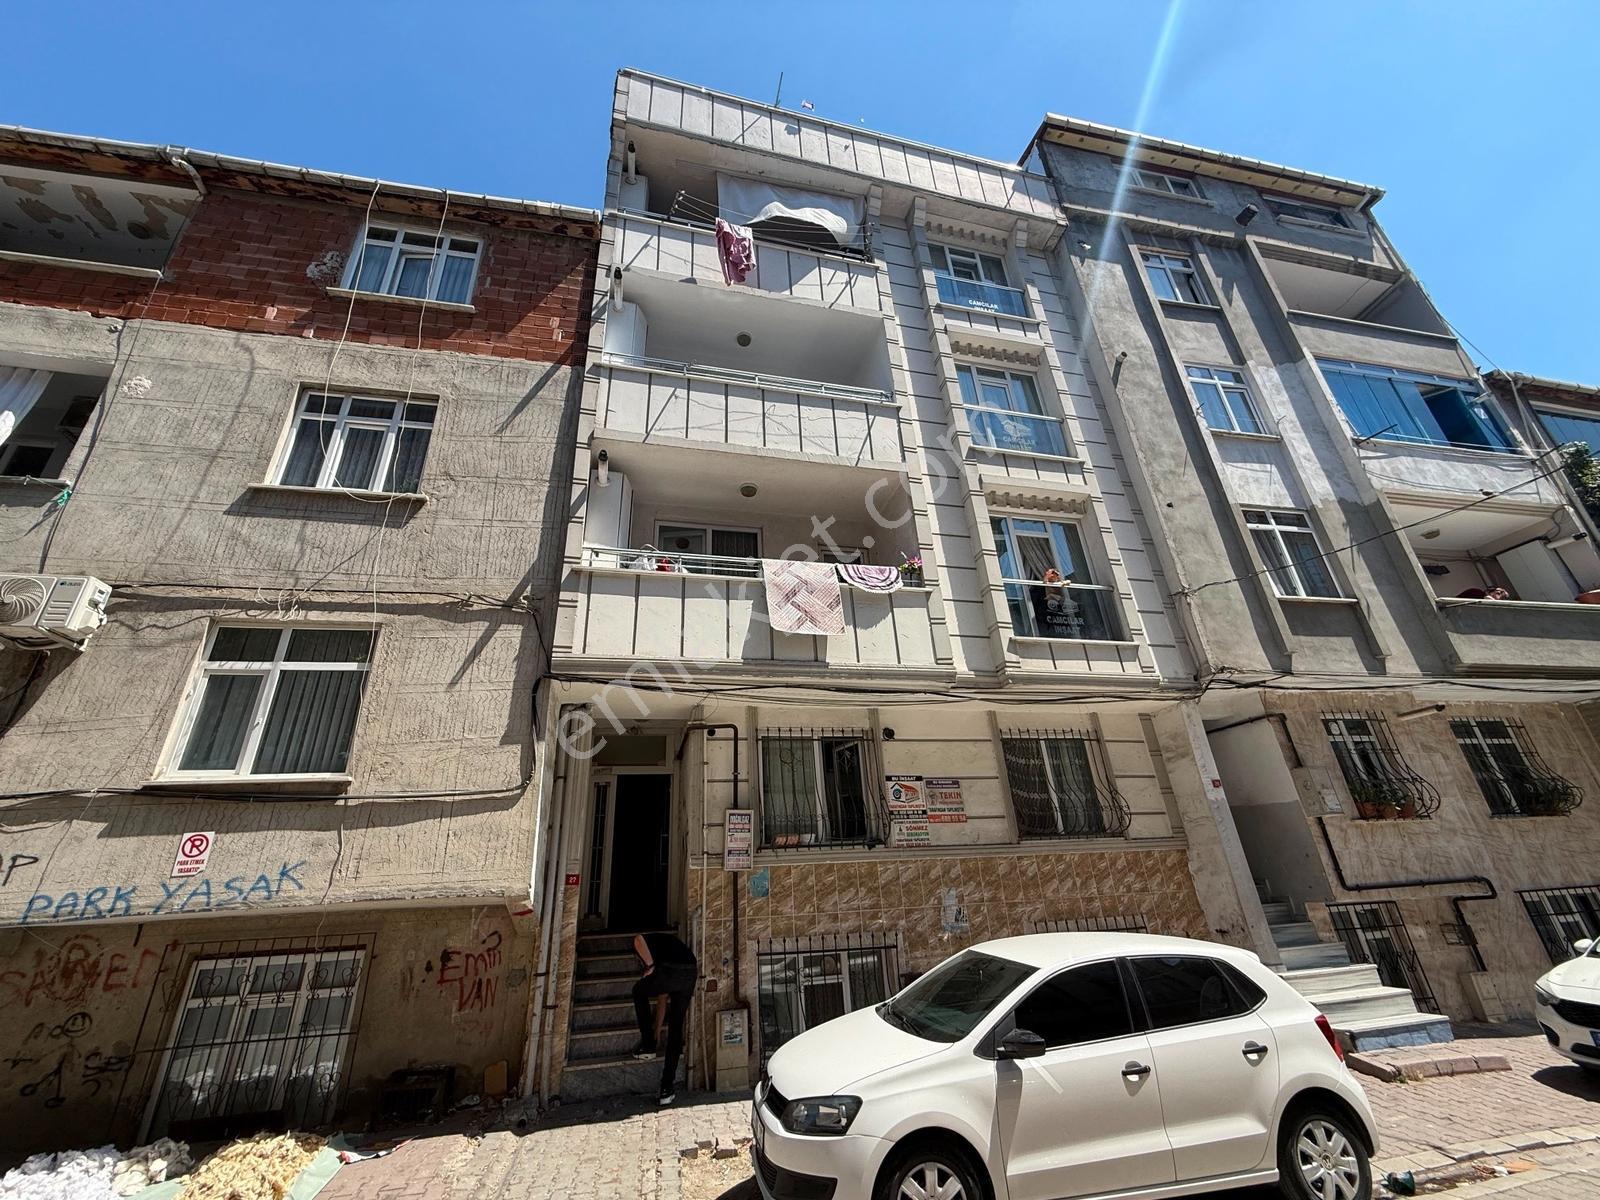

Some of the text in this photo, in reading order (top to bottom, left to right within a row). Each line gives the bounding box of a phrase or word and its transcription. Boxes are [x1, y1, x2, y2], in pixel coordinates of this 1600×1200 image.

[1046, 615, 1085, 625] CAMCILAR
[19, 860, 306, 925] PARK YASAK
[457, 976, 499, 1012] VAN
